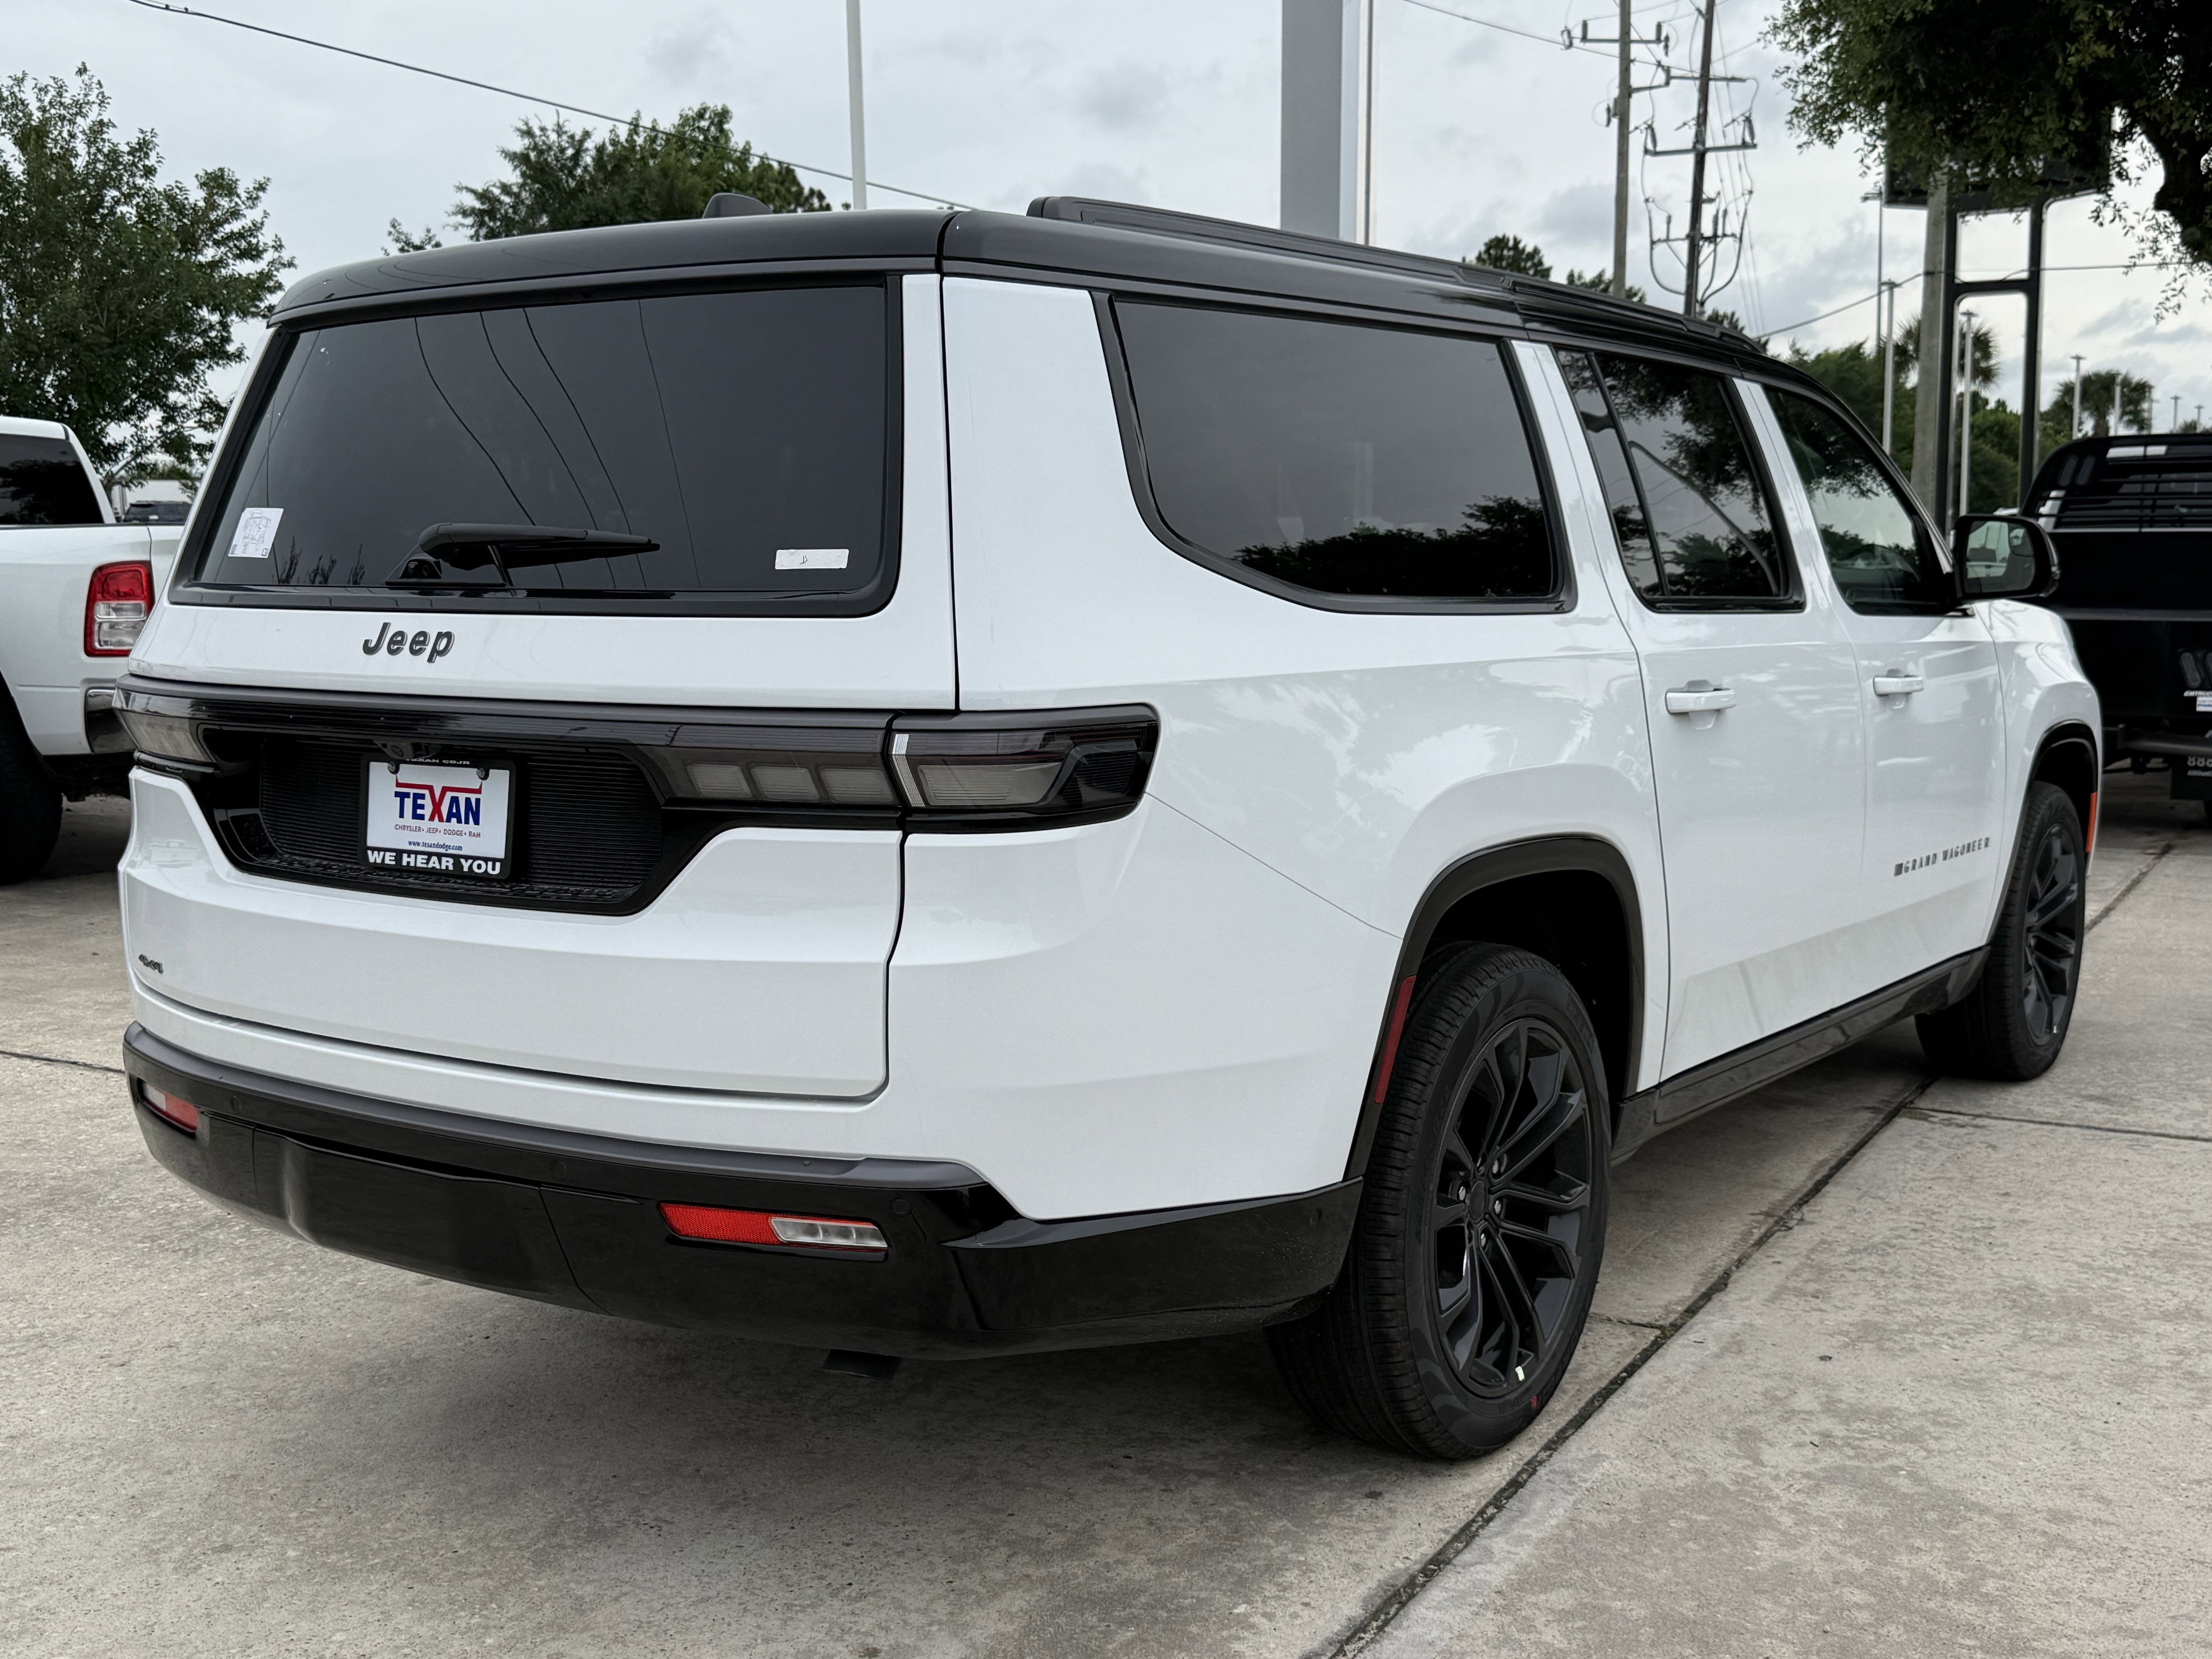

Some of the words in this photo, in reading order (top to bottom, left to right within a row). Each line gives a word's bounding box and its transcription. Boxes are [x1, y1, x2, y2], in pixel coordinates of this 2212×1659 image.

[362, 622, 455, 663] Jeep
[394, 785, 482, 826] TEXAN
[394, 824, 421, 832] CHRYSLER
[443, 828, 463, 836] DODGE
[408, 840, 463, 851] www.texandodge.com
[368, 850, 396, 865] WE
[402, 853, 454, 871] HEAR
[460, 858, 501, 875] YOU
[1904, 853, 1937, 873] GRAND
[1942, 836, 1990, 861] WAGONEER
